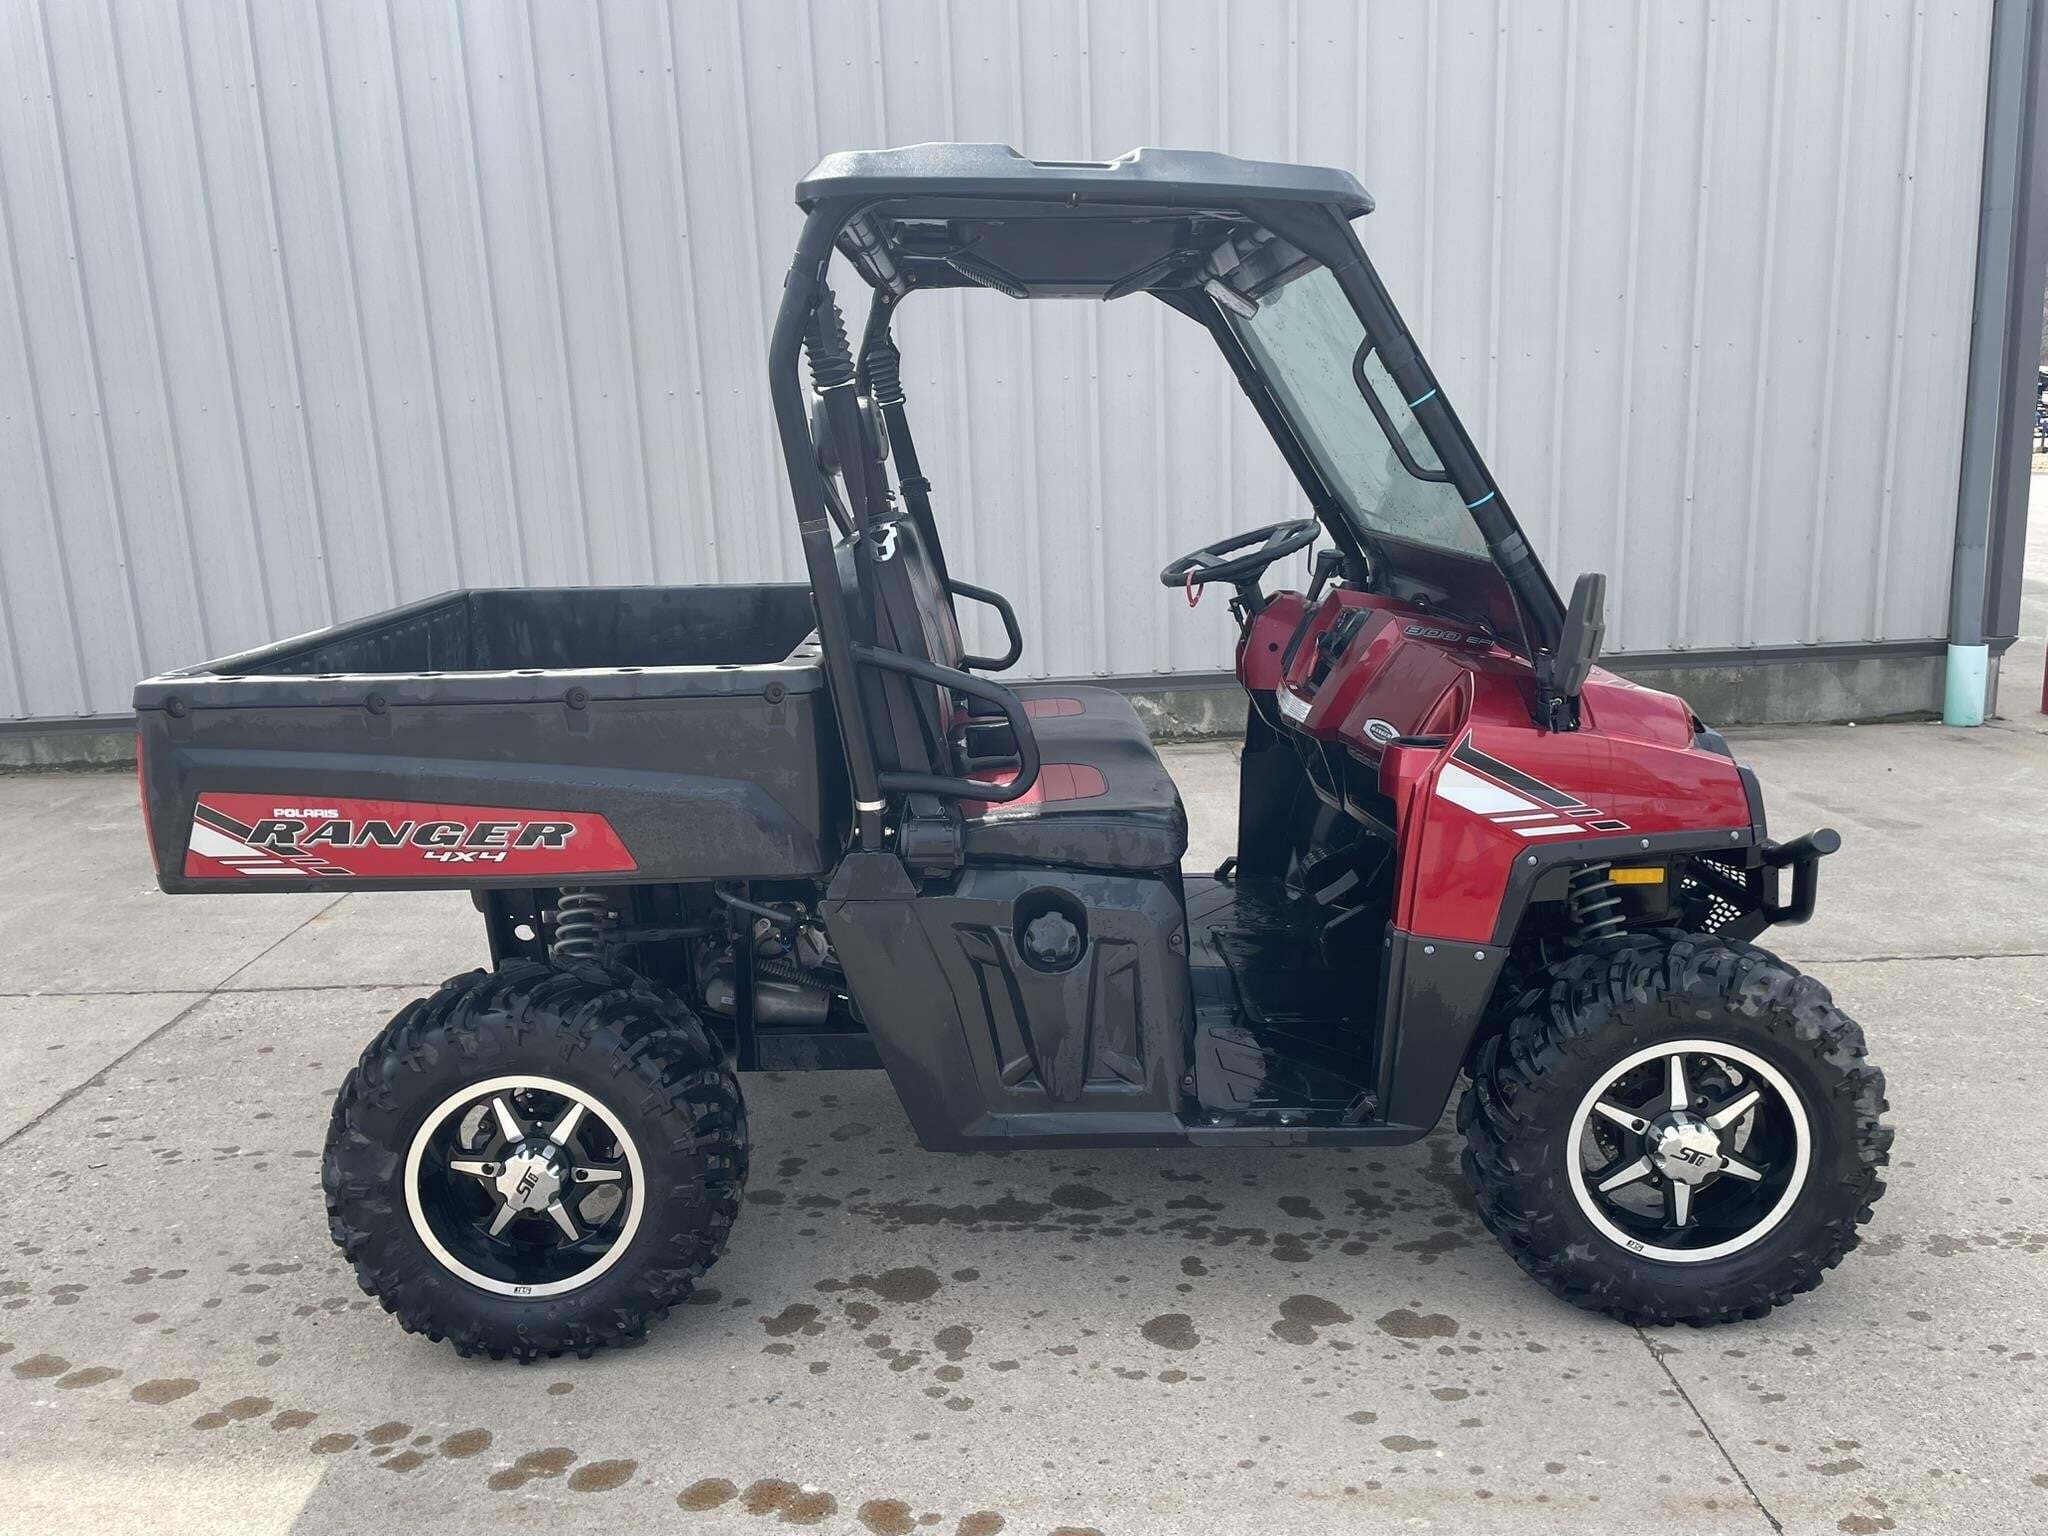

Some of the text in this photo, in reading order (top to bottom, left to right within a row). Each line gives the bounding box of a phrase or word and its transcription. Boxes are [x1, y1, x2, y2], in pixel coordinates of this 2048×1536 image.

[1404, 625, 1461, 642] 800
[273, 808, 339, 818] POLARIS
[245, 818, 577, 850] RANGER
